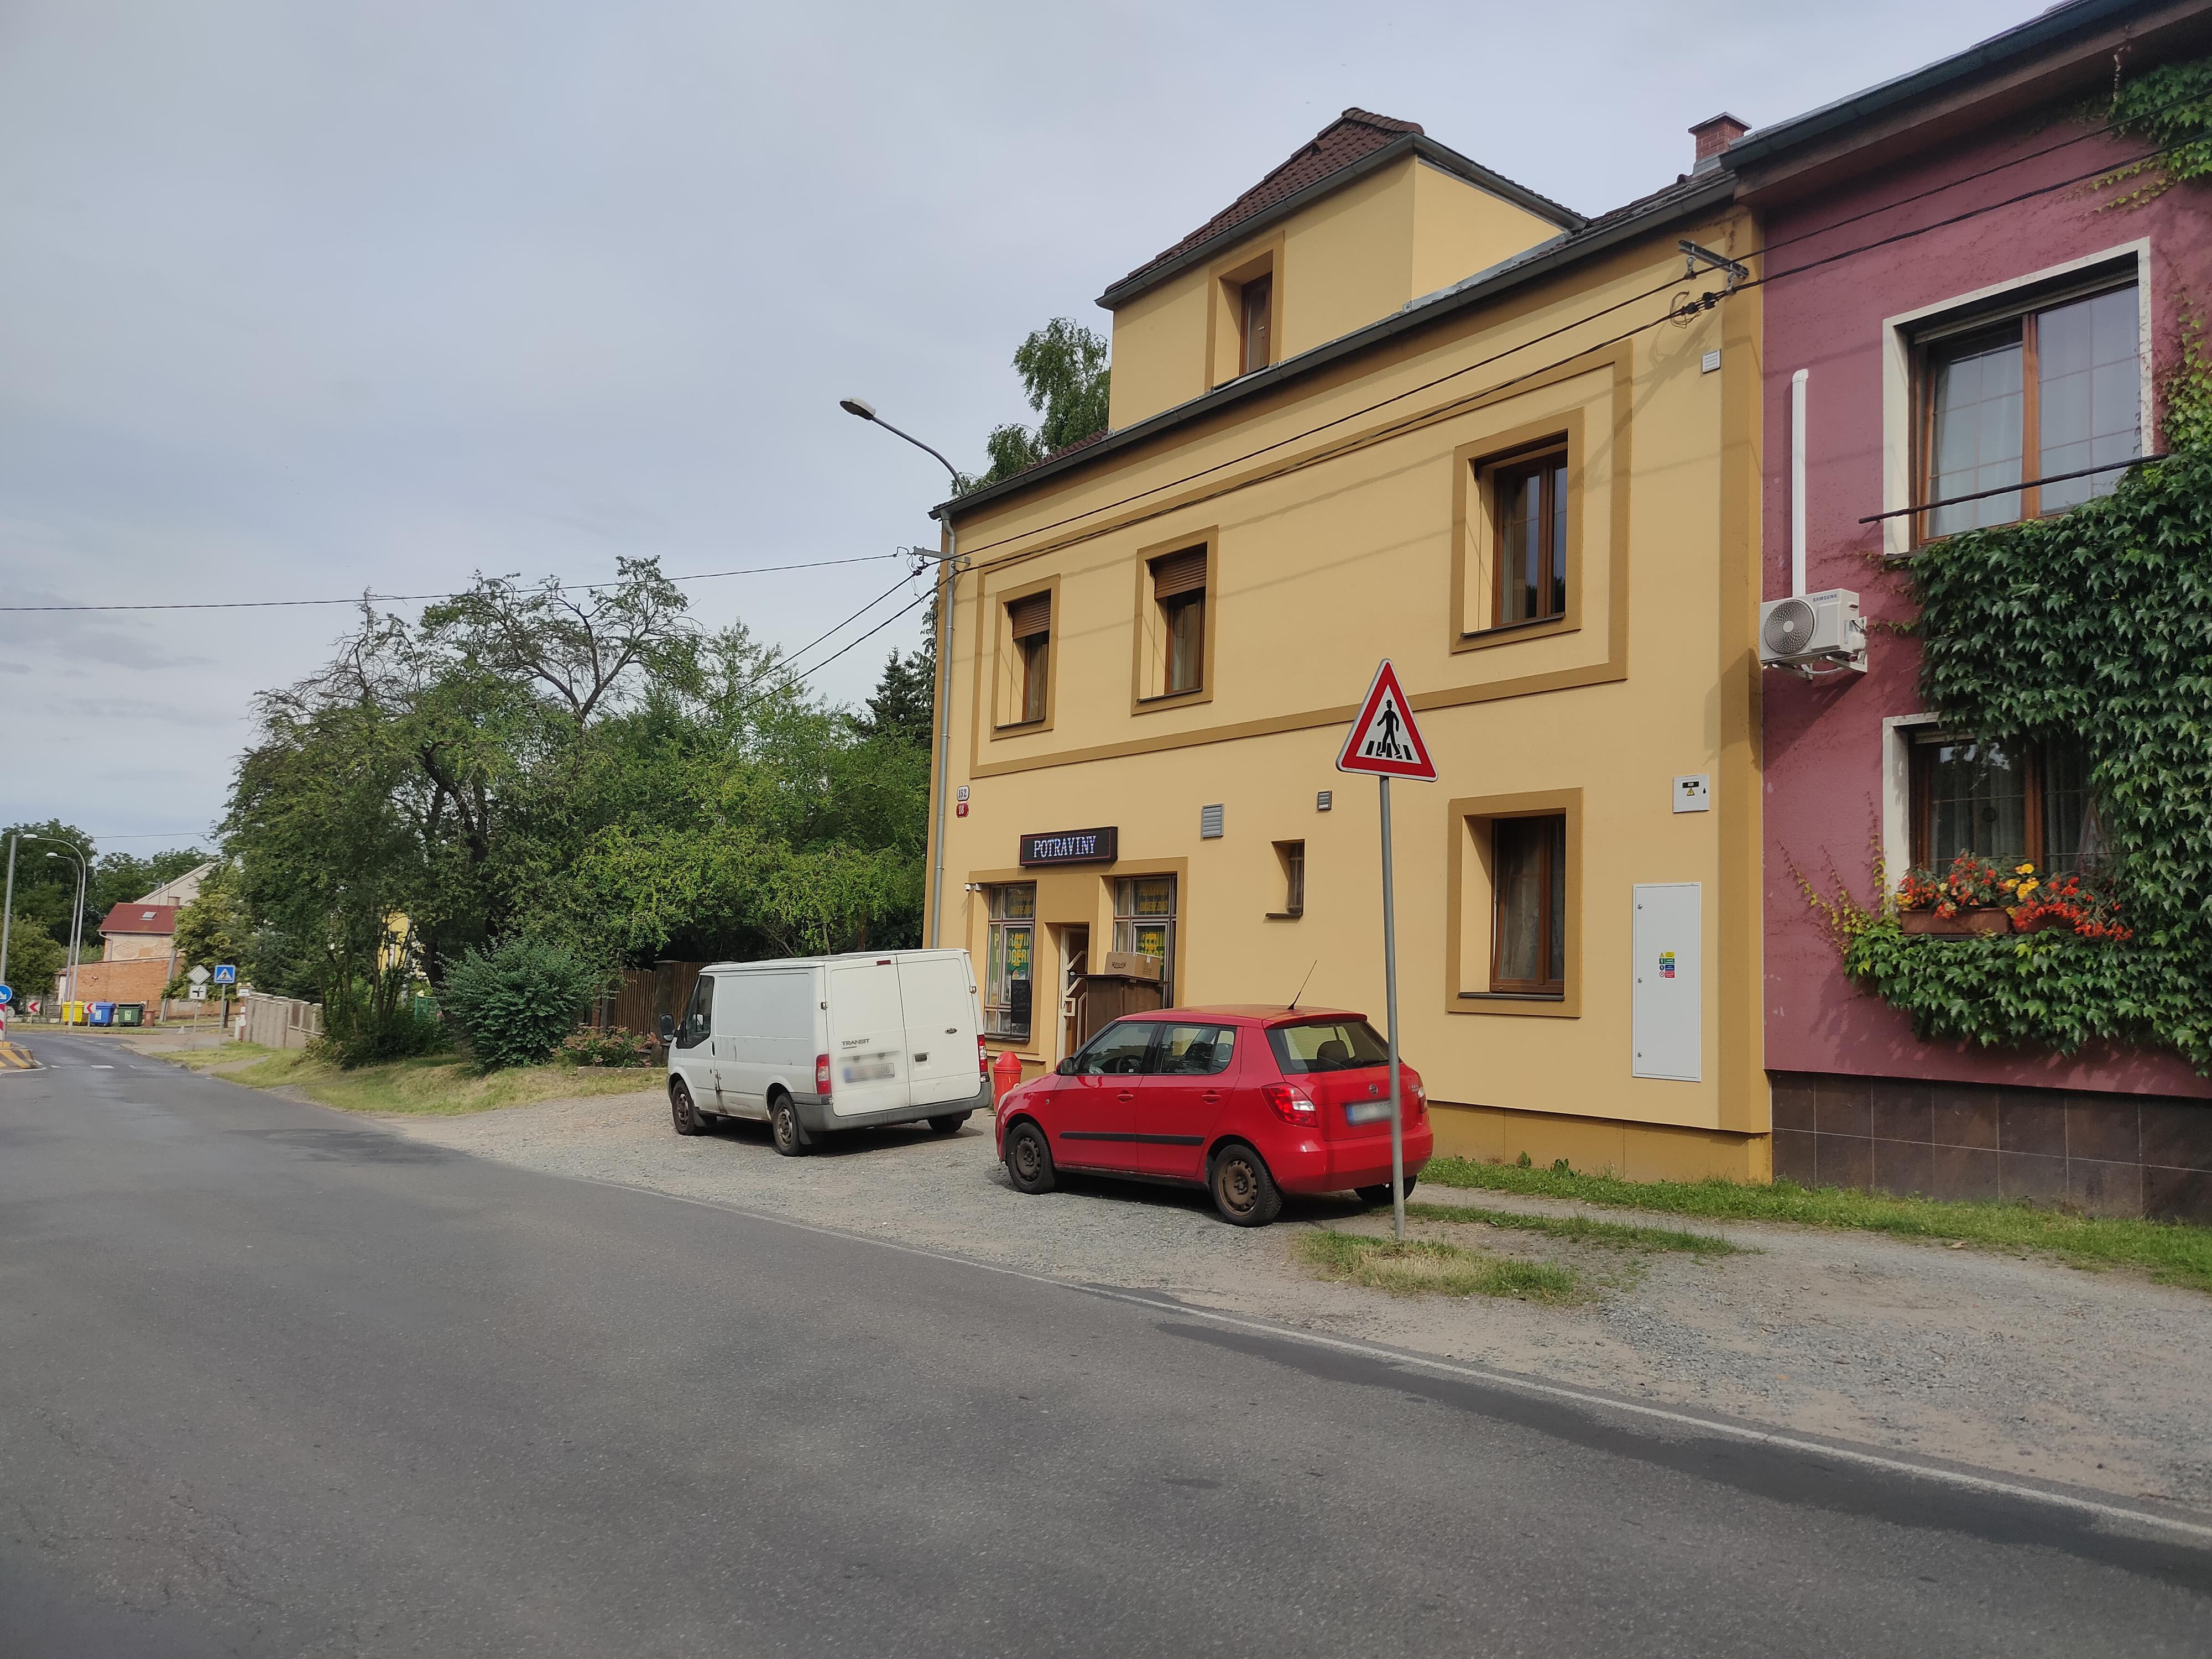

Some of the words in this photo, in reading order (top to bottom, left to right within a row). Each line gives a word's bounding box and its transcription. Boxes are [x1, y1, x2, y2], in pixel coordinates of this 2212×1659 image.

[958, 789, 967, 798] 152
[958, 805, 964, 814] 18
[1034, 836, 1096, 858] POTRAVINY
